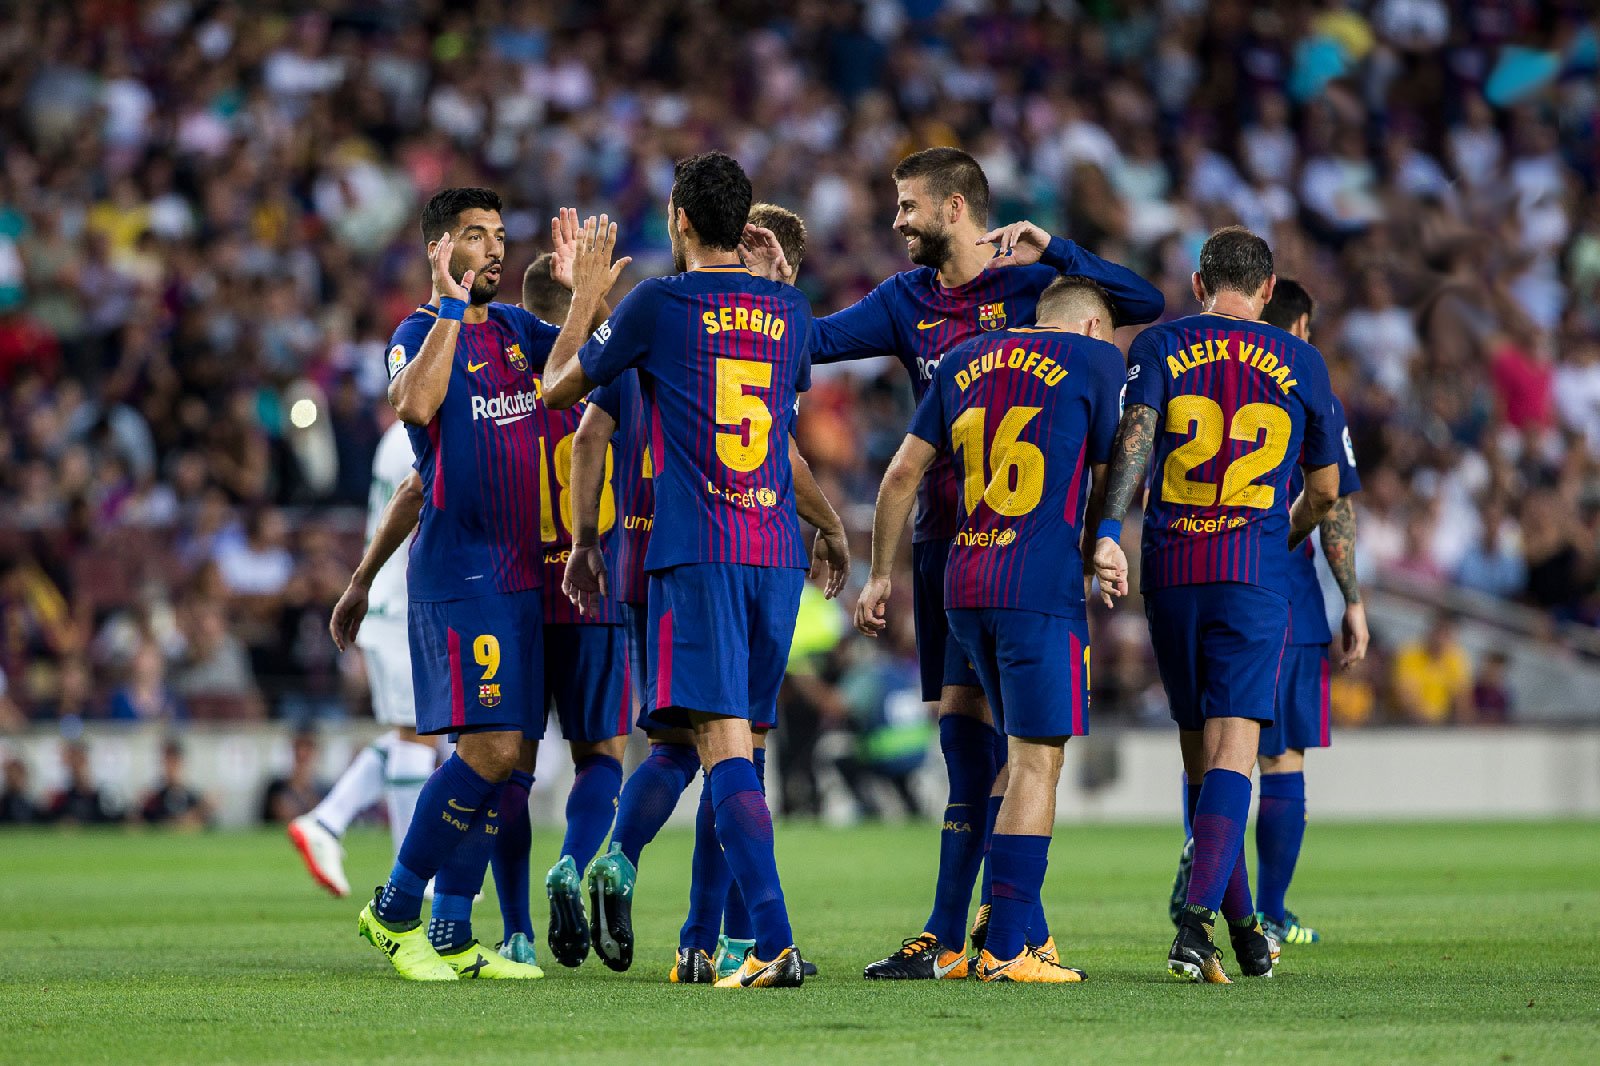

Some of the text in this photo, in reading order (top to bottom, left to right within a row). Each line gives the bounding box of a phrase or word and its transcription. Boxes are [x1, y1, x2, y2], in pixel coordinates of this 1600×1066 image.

[702, 307, 785, 341] SERGIO
[954, 347, 1069, 392] DEULOFEU
[1166, 338, 1298, 396] ALEIX VIDAL
[715, 357, 773, 473] 5
[951, 405, 1045, 517] 16
[1161, 394, 1292, 510] 22
[707, 481, 756, 508] uicef
[624, 514, 654, 532] uni
[953, 527, 999, 548] nicef
[472, 634, 501, 680] 9
